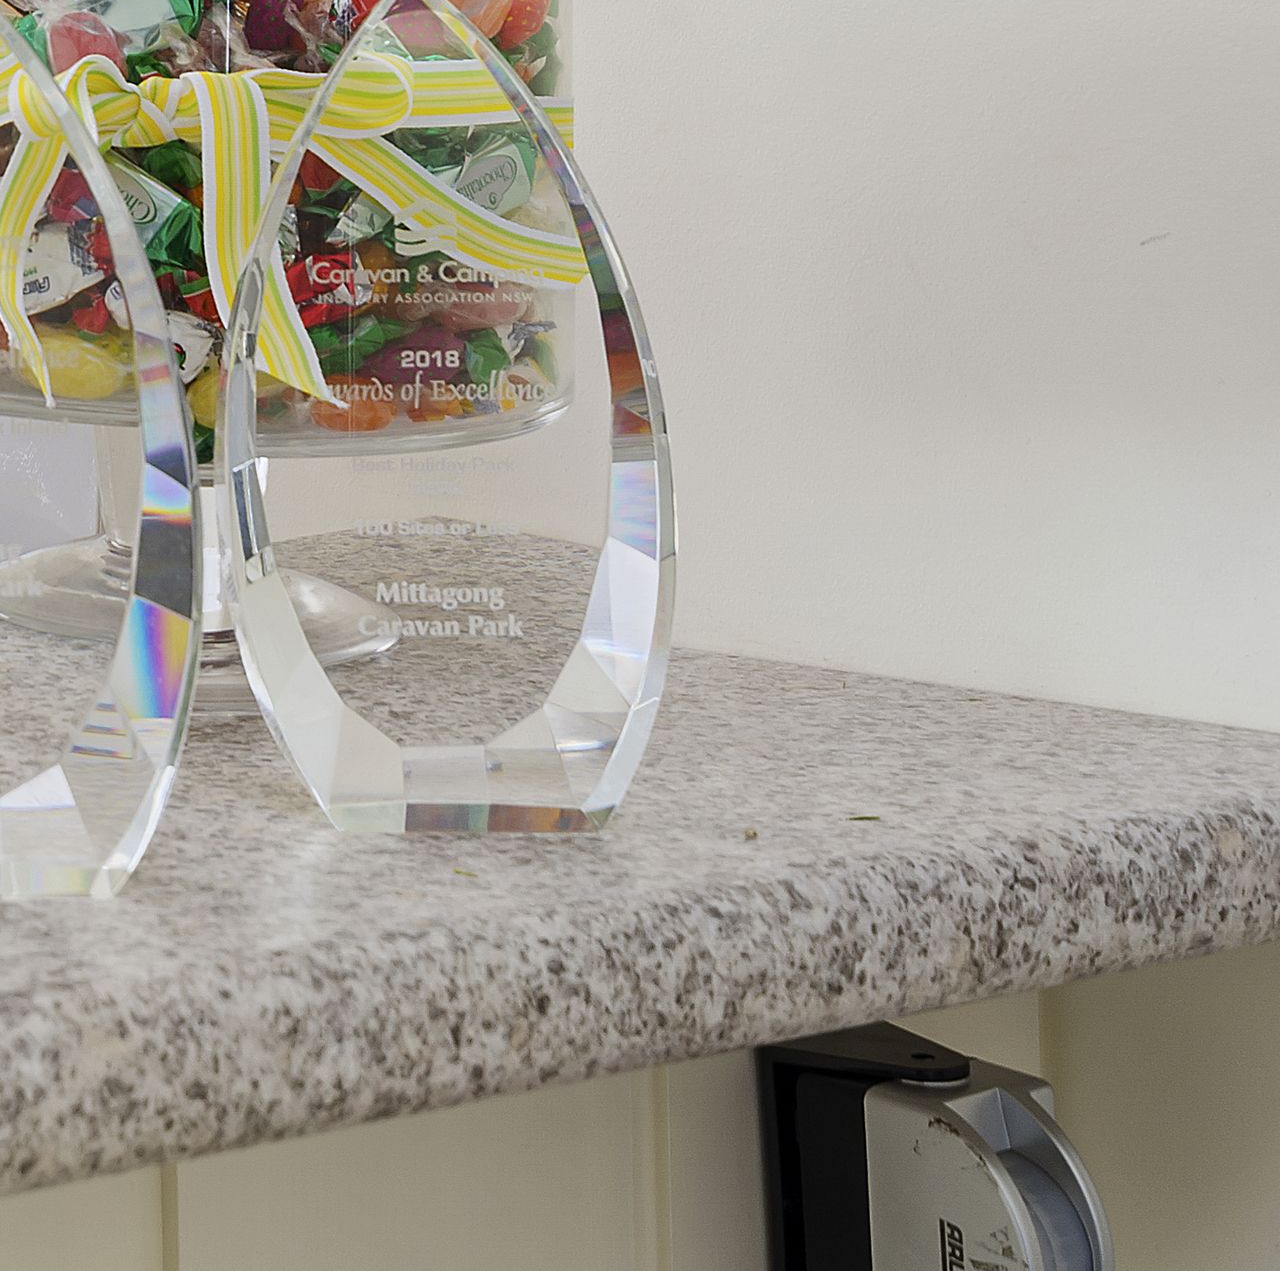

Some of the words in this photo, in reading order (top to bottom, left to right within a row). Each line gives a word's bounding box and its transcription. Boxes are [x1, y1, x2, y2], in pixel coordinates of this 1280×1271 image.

[417, 264, 434, 285] &
[394, 291, 489, 304] ASSOCIATION
[500, 291, 534, 303] NSW
[400, 350, 460, 369] 2018
[400, 370, 423, 410] of
[431, 369, 559, 402] Excellence
[375, 580, 506, 612] Mittagong
[356, 614, 461, 637] Caravan
[467, 613, 525, 637] Park
